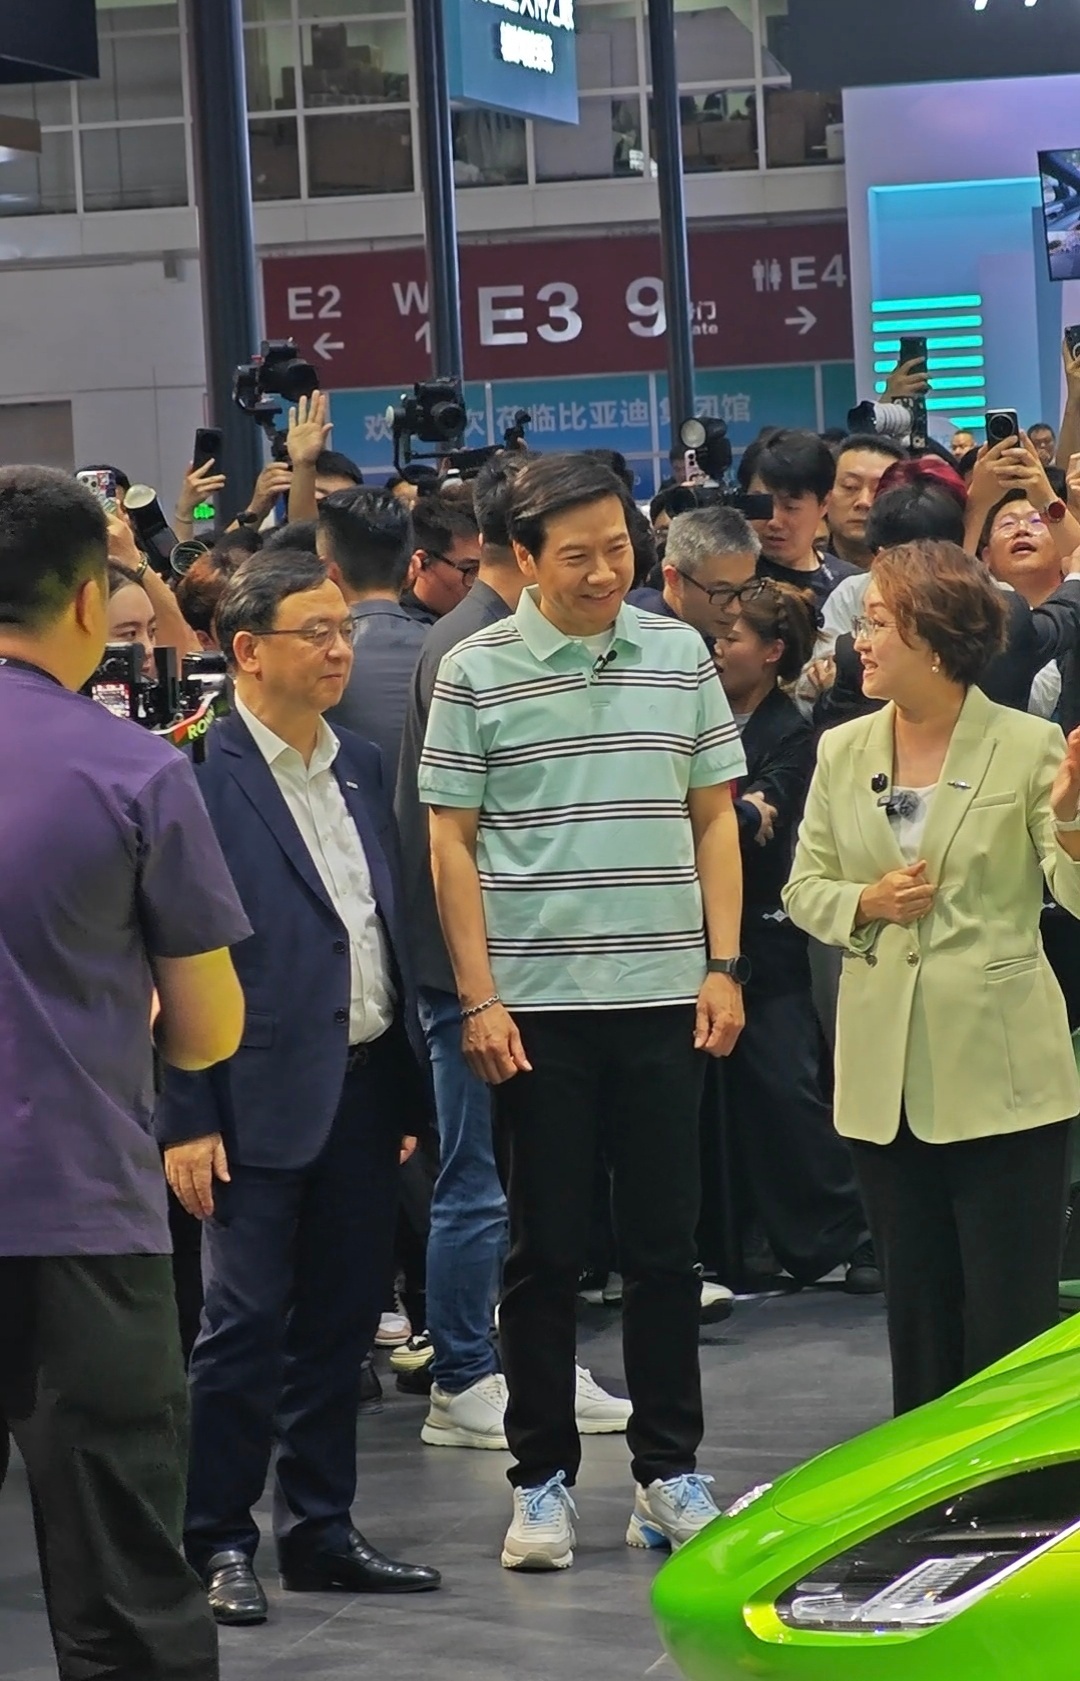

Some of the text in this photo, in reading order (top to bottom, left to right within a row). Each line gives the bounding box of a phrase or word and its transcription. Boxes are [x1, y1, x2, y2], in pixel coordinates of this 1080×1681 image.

[790, 253, 846, 291] E4
[287, 284, 342, 321] E2
[477, 281, 583, 346] E3
[625, 276, 668, 337] 9
[691, 323, 719, 335] ate
